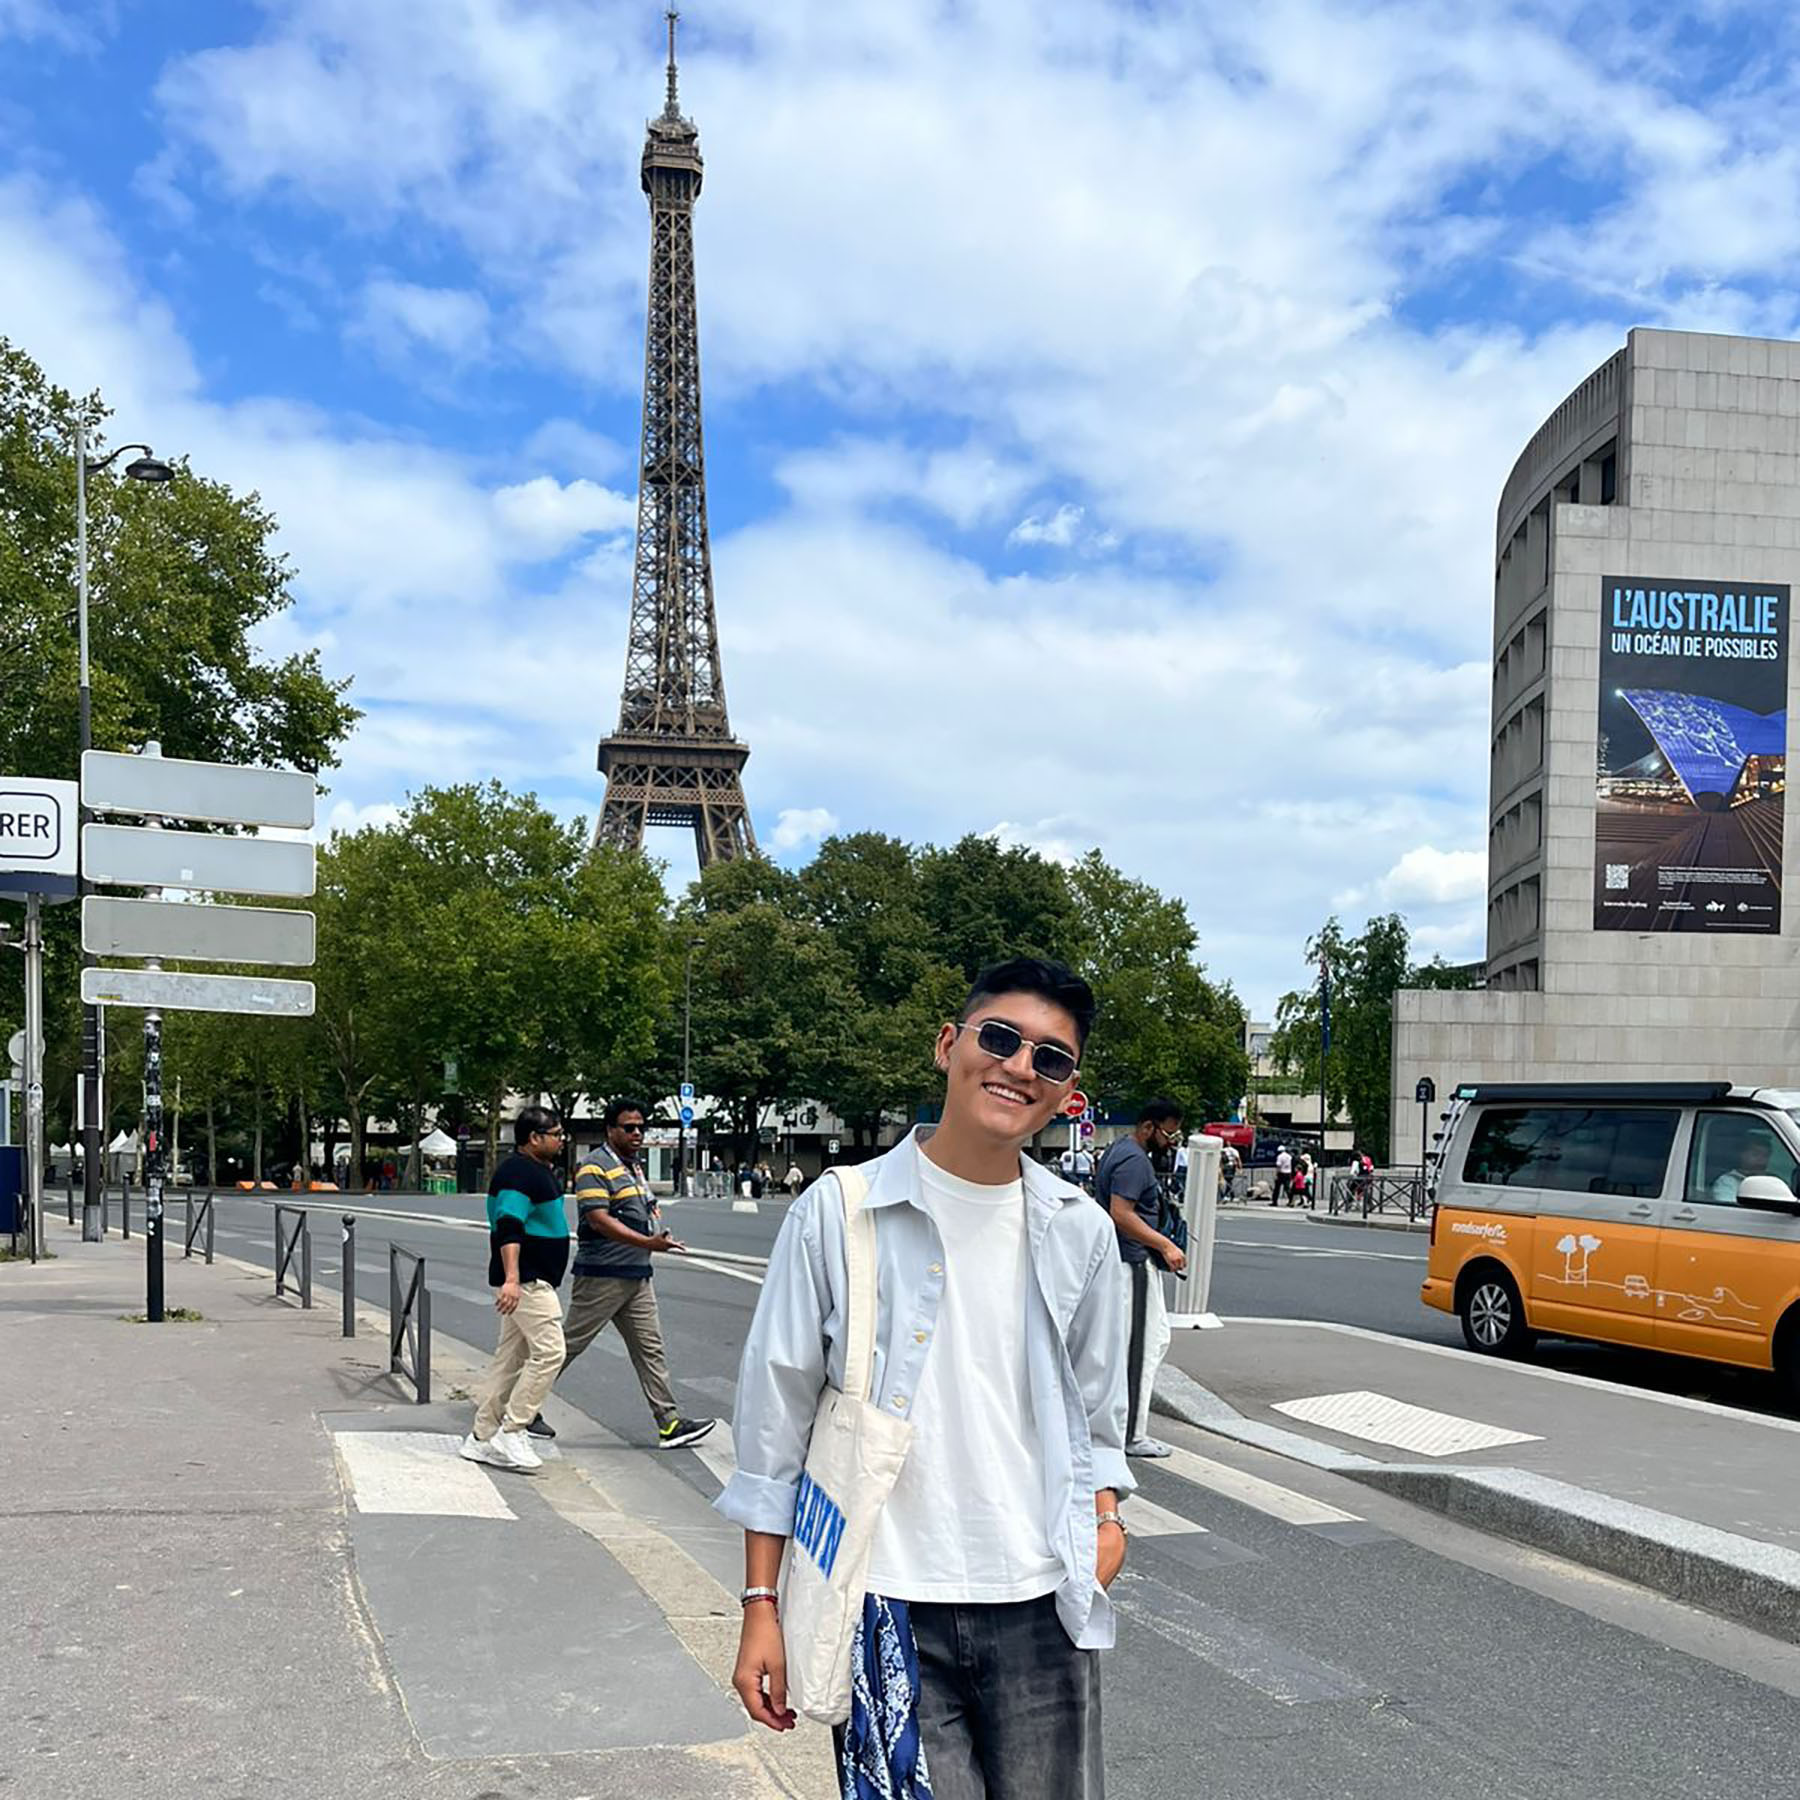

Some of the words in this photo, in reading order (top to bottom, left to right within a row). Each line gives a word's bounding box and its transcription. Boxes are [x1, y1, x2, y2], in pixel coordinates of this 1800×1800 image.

[1613, 588, 1778, 634] L'AUSTRALIE
[1611, 633, 1631, 653] UN
[1634, 631, 1680, 656] OCÉAN
[1684, 636, 1702, 656] DE
[1705, 637, 1778, 660] POSSIBLES
[0, 813, 49, 838] RER
